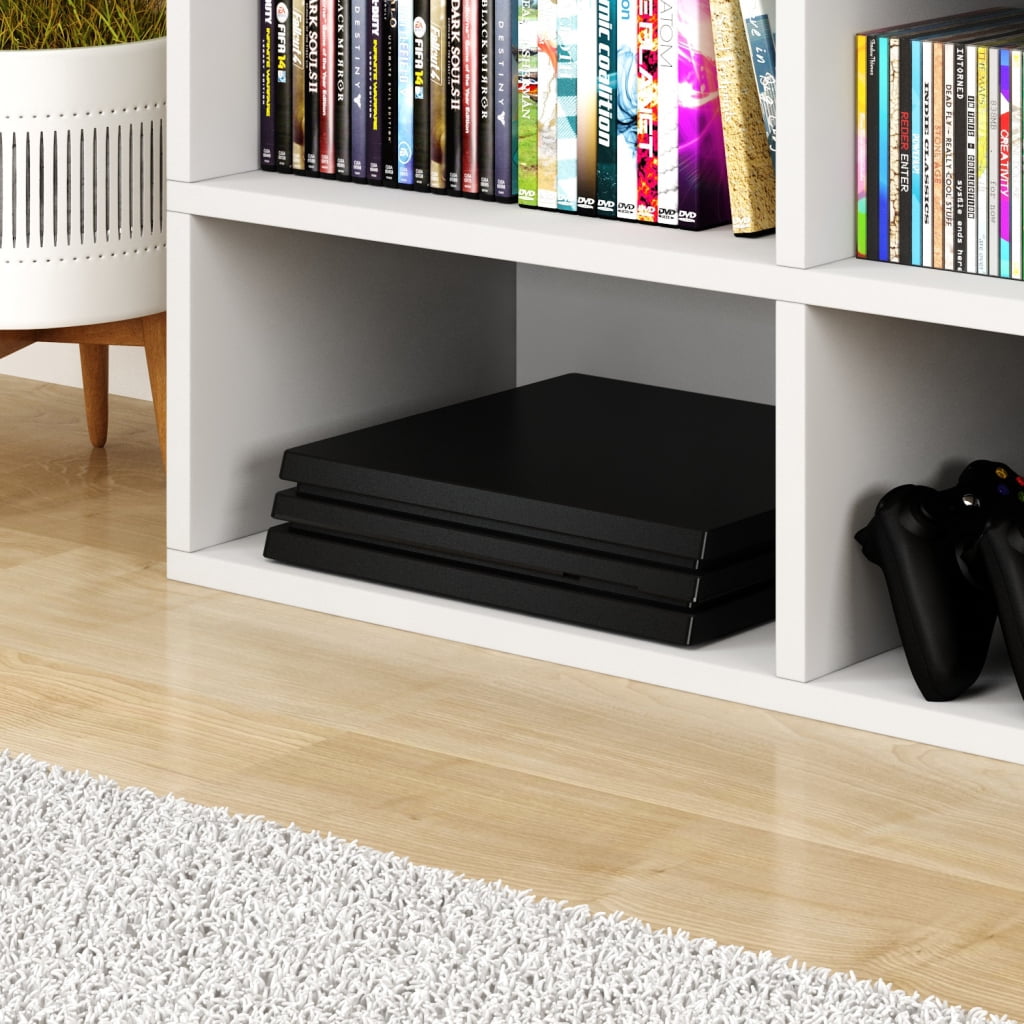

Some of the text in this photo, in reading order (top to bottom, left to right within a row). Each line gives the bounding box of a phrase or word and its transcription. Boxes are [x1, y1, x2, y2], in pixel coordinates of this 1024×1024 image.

[278, 24, 286, 69] FIFA 14
[293, 12, 302, 53] Fallout
[431, 24, 440, 68] Fallout
[660, 0, 673, 68] ATOM
[755, 46, 766, 63] in
[309, 31, 318, 80] SOULS
[415, 39, 424, 85] FIFA 14
[451, 46, 460, 97] SOULS
[309, 82, 318, 94] II
[451, 98, 460, 110] II
[598, 42, 612, 148] coalition
[639, 22, 653, 158] PLANET
[900, 154, 909, 192] ENTER
[1000, 129, 1009, 198] CREATIVITY
